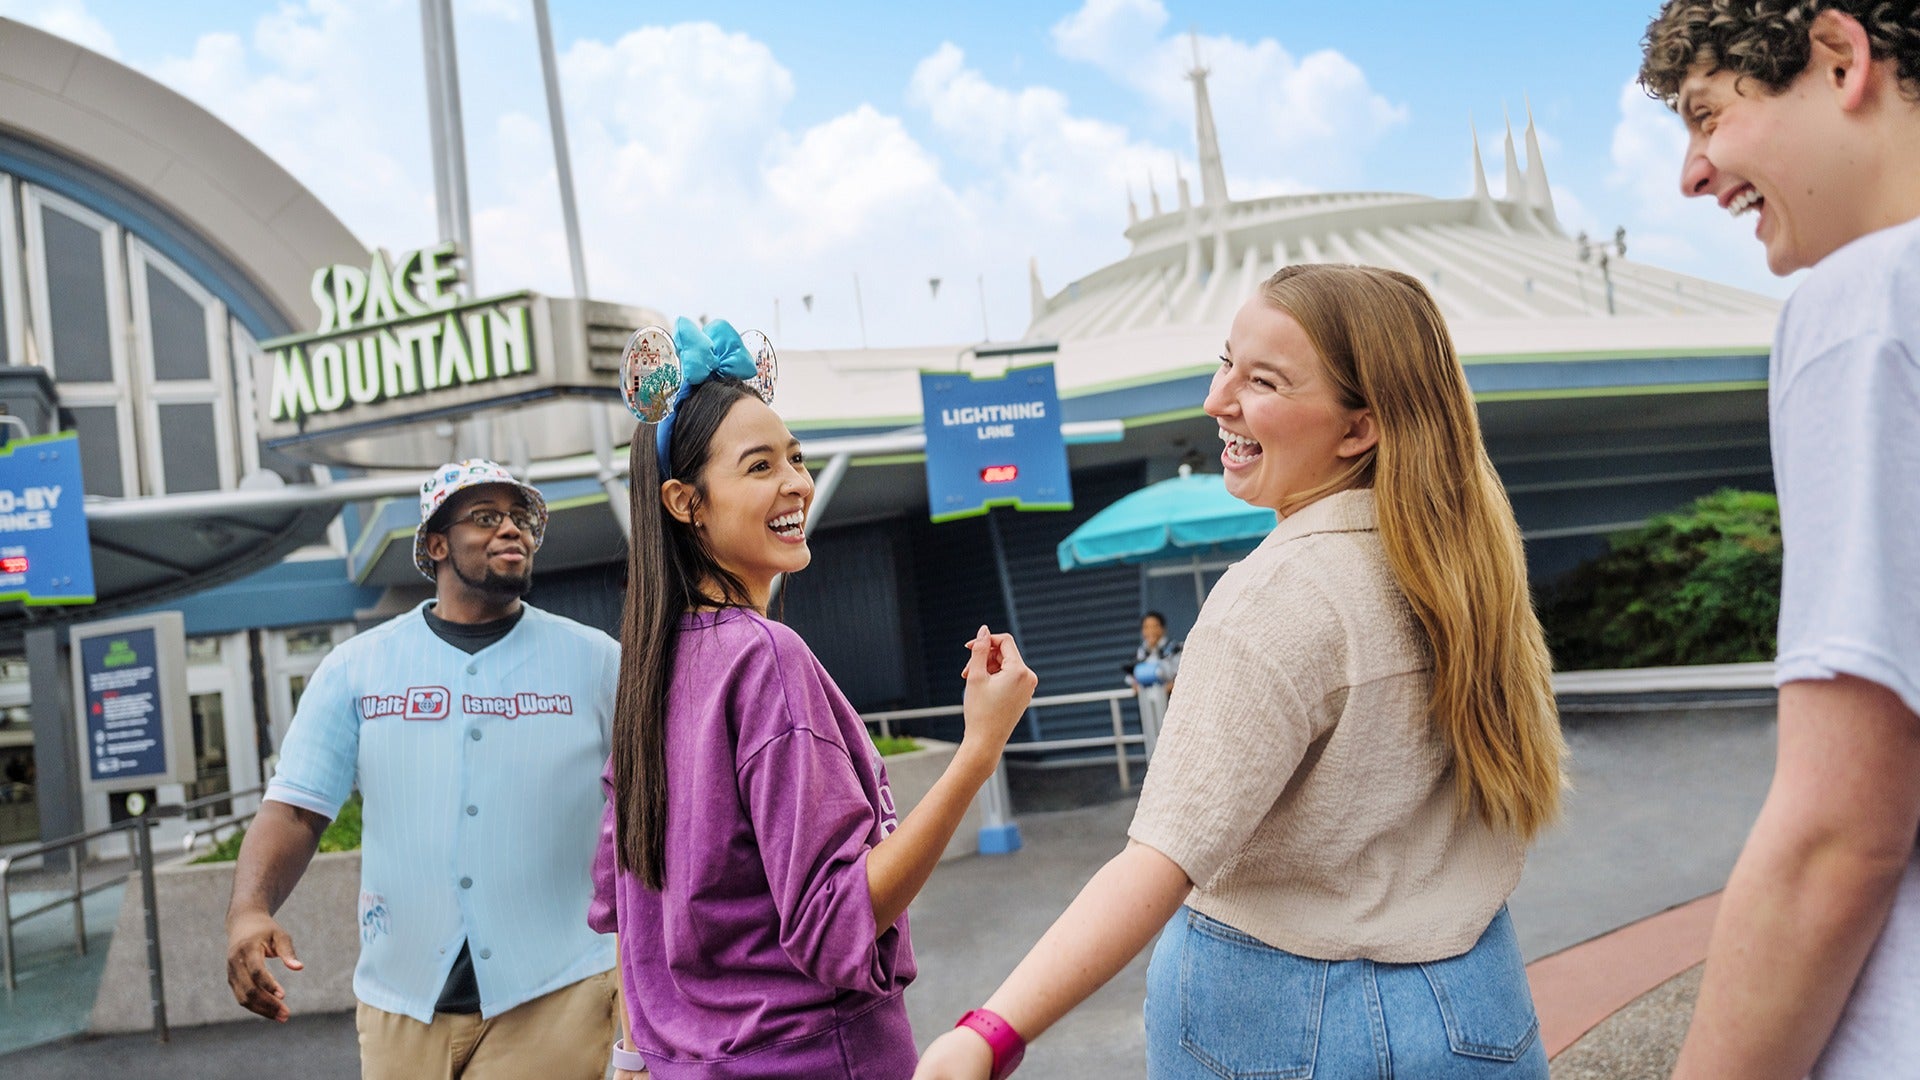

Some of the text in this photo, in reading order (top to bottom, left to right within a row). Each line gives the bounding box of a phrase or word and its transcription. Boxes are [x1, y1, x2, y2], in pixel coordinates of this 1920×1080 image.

[311, 241, 458, 335] SPACE
[269, 306, 529, 421] MOUNTAIN
[942, 401, 1045, 426] LIGHTNING
[977, 424, 1014, 440] LANE
[362, 695, 404, 719] Walt
[516, 693, 572, 715] World
